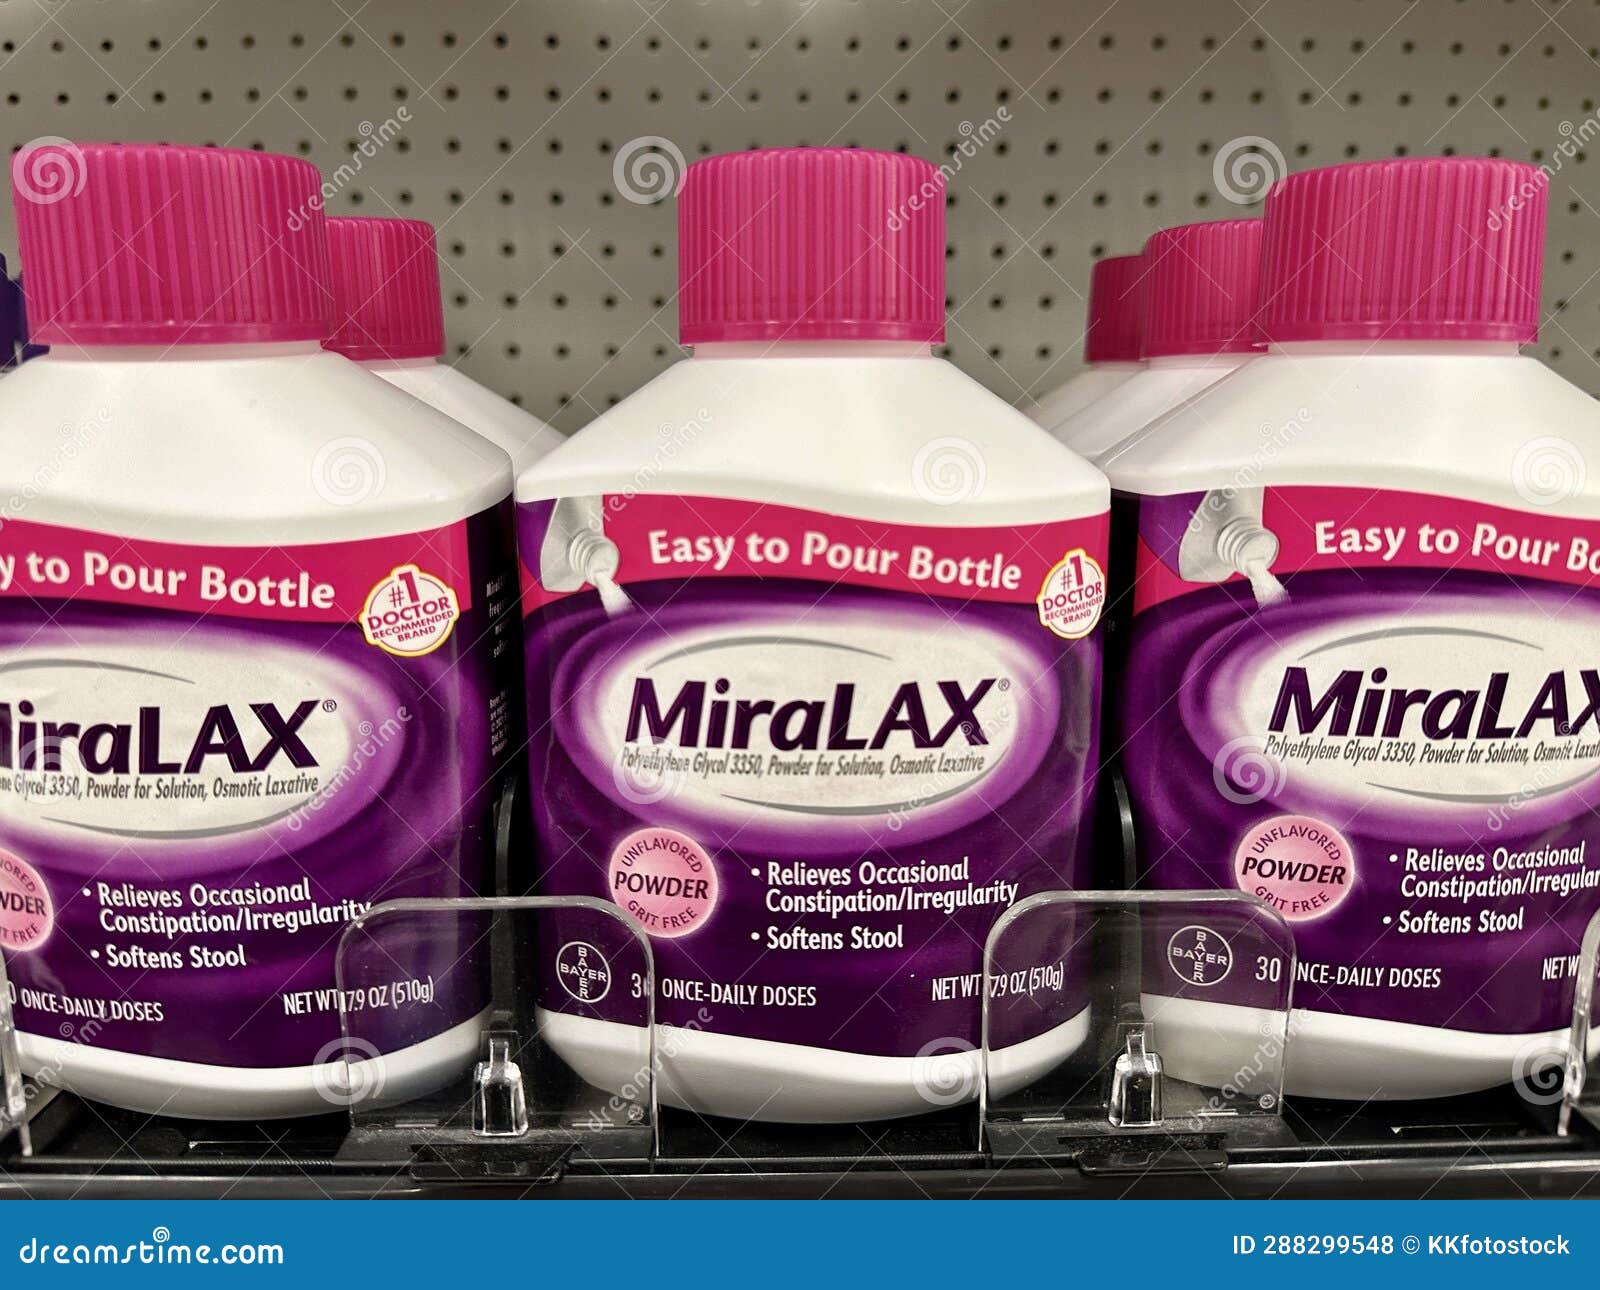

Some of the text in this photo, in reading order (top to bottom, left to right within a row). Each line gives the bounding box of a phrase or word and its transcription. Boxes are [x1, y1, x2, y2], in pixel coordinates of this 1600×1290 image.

[1315, 520, 1406, 561] Easy
[1417, 523, 1460, 554] to
[1472, 522, 1561, 567] Pour
[648, 530, 1022, 590] Easy to Pour Bottle
[1060, 554, 1084, 591] #1
[26, 551, 70, 584] to
[84, 551, 187, 596] Pour
[201, 565, 335, 609] Bottle
[389, 571, 420, 608] #1
[1042, 581, 1102, 612] DOCTOR
[1044, 595, 1103, 621] RECOMMENDED
[367, 596, 451, 631] DOCTOR
[372, 610, 454, 640] RECOMMENDED
[1063, 609, 1092, 625] BRAND
[397, 625, 437, 642] BRAND
[620, 746, 985, 779] Polyethylene Glycol 3350, Powder for Solution, Osmotic Laxative
[1264, 734, 1600, 767] Polyethylene Glycol 3350, Powder for Solution, Osmotic Laxat
[14, 773, 47, 801] Glycol
[49, 774, 82, 801] 3350,
[87, 776, 130, 800] Powder
[133, 776, 152, 800] for
[155, 776, 208, 802] Solution,
[213, 776, 262, 798] Osmotic
[265, 772, 318, 796] Laxative
[622, 837, 703, 873] UNFLAVORED
[1252, 824, 1341, 861] UNFLAVORED
[1405, 840, 1585, 872] Relieves Occasional
[614, 871, 709, 900] POWDER
[767, 857, 969, 886] Relieves Occasional
[1242, 856, 1346, 885] POWDER
[1401, 865, 1600, 904] Constipation/Irregular
[97, 876, 311, 908] Relieves Occasional
[766, 880, 1019, 918] Constipation/Irregularity
[1255, 885, 1330, 912] GRIT FREE
[100, 898, 371, 939] Constipation/Irregularity
[628, 900, 698, 928] GRIT FREE
[1398, 906, 1524, 933] Softens Stool
[12, 923, 39, 942] FREE
[767, 925, 904, 950] Softens Stool
[105, 943, 247, 969] Softens Stool
[1173, 947, 1227, 966] BAYER
[1542, 954, 1581, 980] NET W
[560, 962, 607, 982] BAYER
[932, 961, 1064, 1001] NET WT 7.9 OZ (510g)
[1255, 956, 1441, 988] 30 NCE-DAILY DOSES
[21, 988, 105, 1019] ONCE-DAILY
[110, 1000, 164, 1021] DOSES
[283, 991, 313, 1016] NET
[315, 988, 338, 1011] WT
[368, 985, 390, 1008] OZ
[391, 975, 434, 1010] (510g)
[662, 978, 758, 1006] ONCE-DAILY
[763, 985, 817, 1007] DOSES
